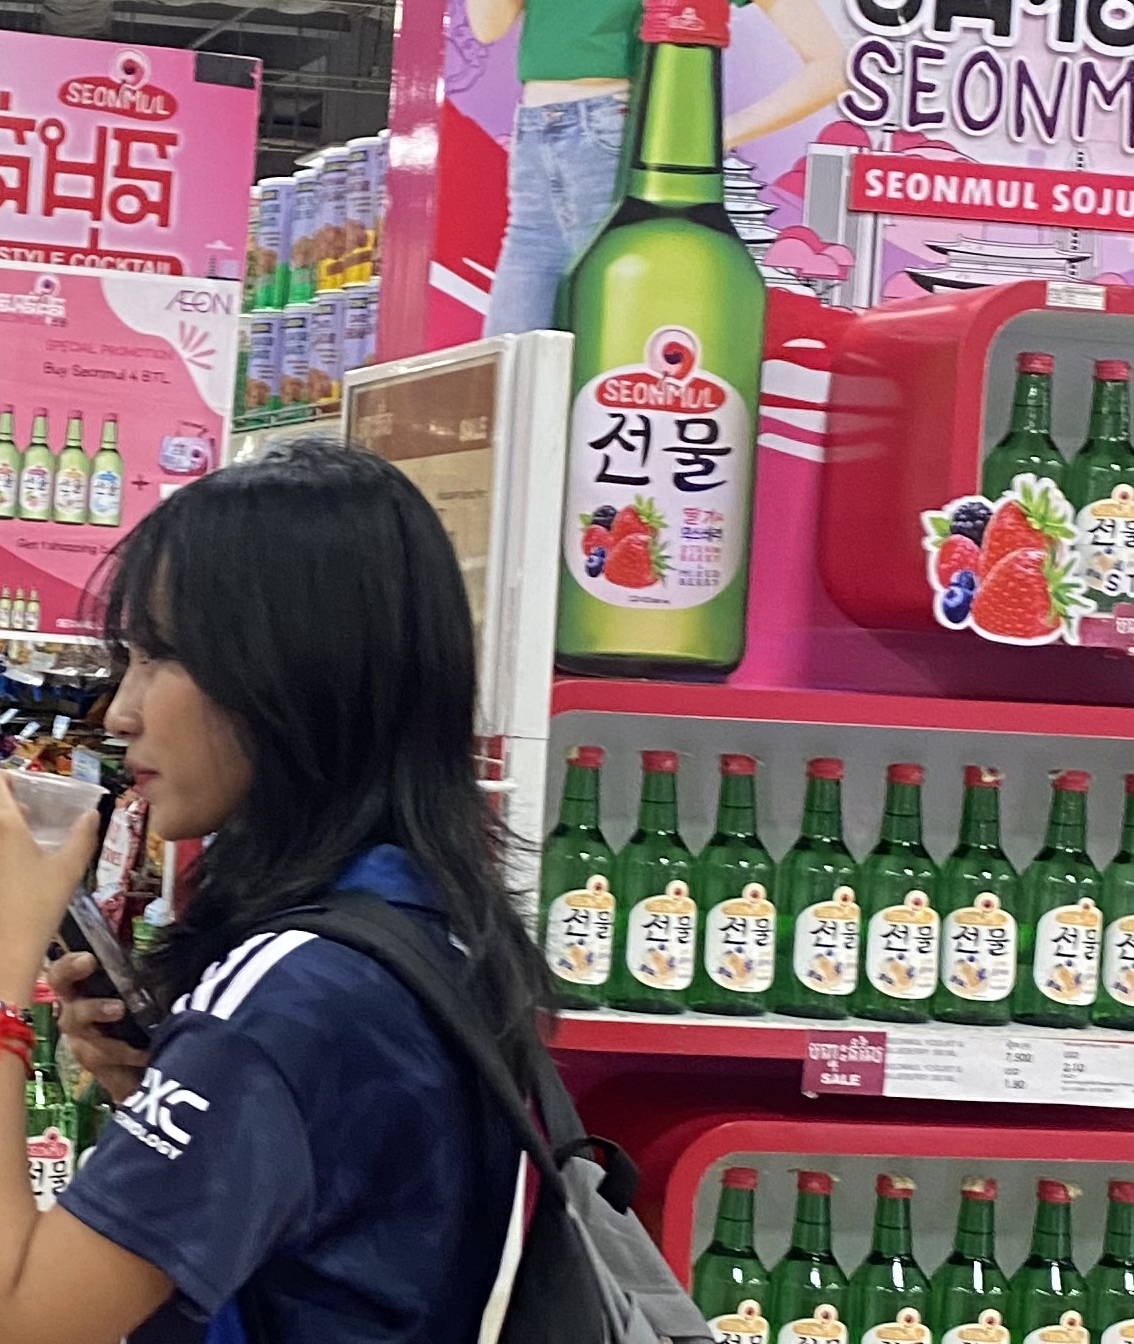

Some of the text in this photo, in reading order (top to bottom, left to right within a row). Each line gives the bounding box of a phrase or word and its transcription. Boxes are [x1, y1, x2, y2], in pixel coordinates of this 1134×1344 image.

[865, 168, 1134, 218] SEONMUL SOJU
[43, 361, 66, 378] Buy
[819, 1072, 861, 1087] SALE
